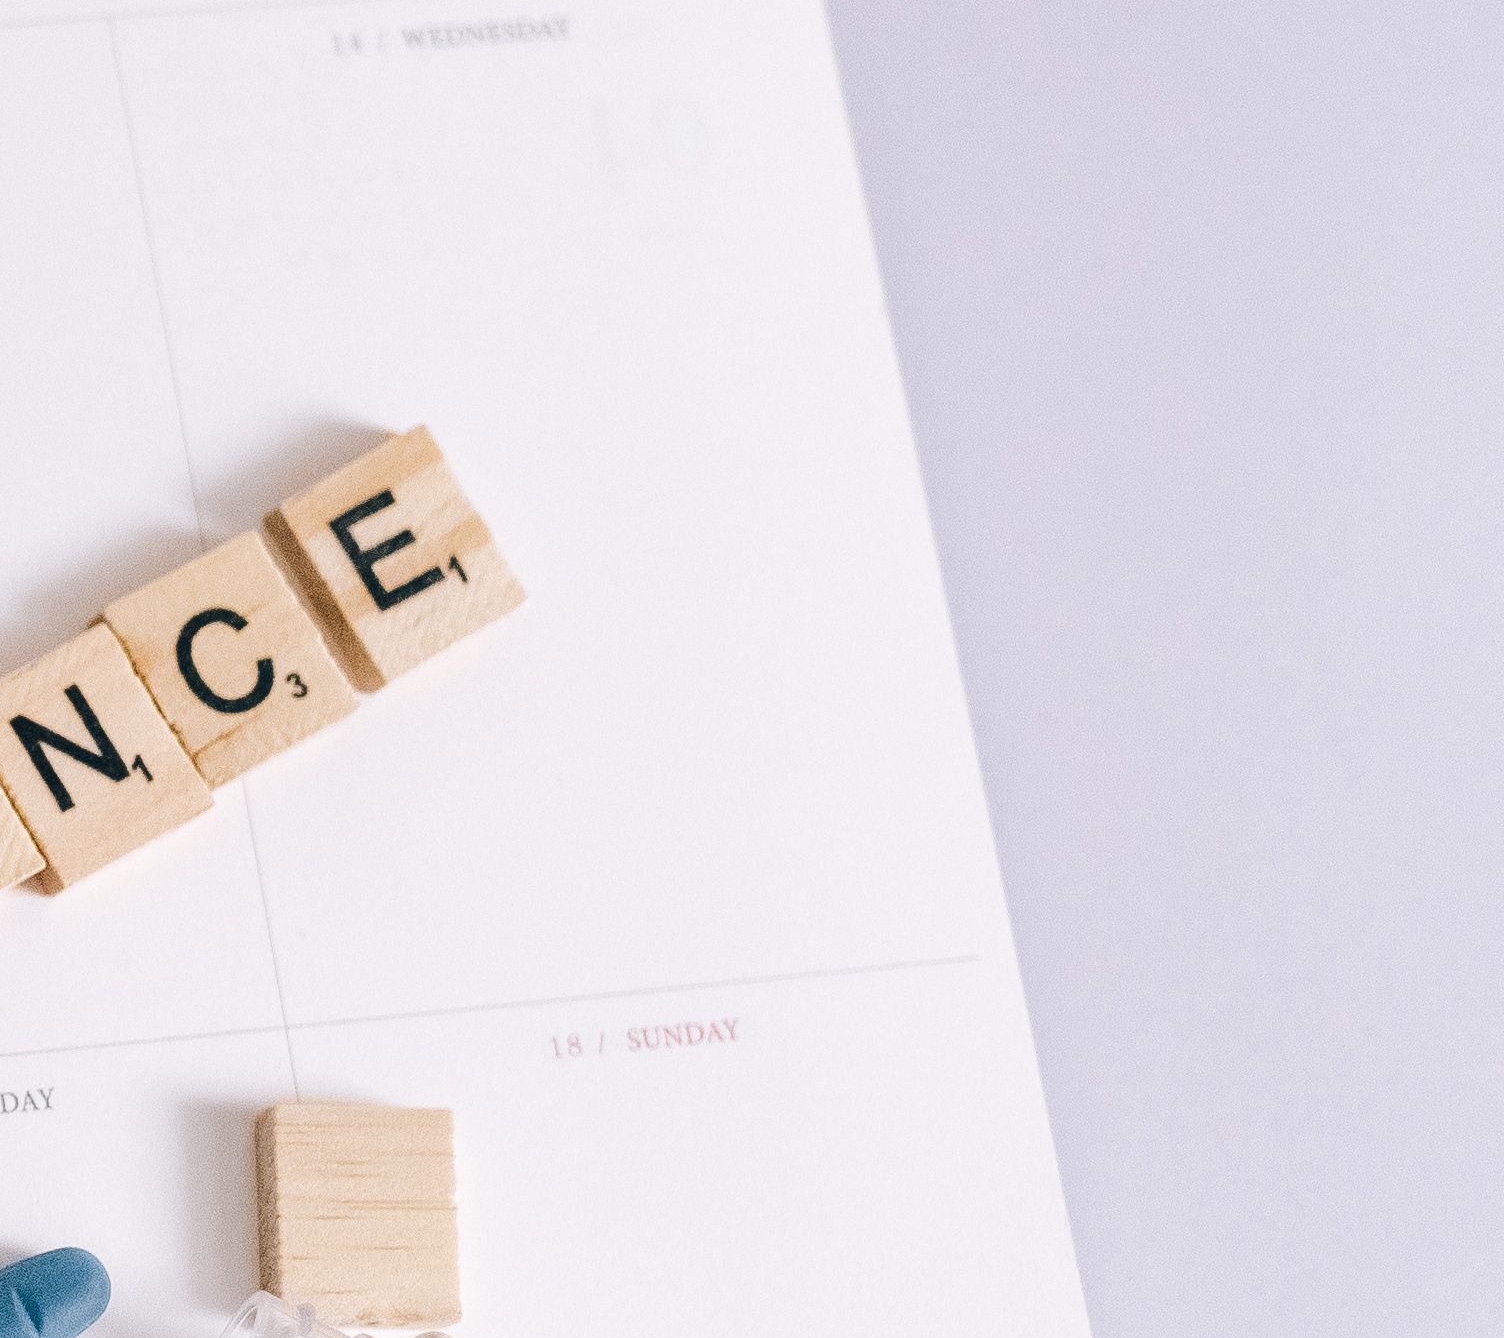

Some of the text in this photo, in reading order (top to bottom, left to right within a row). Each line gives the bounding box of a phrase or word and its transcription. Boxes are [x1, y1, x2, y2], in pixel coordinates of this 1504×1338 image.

[402, 17, 570, 49] WEDNESDAY
[445, 556, 469, 584] 1
[285, 673, 308, 699] 3
[130, 755, 154, 783] 1
[550, 1034, 584, 1059] 18
[626, 1019, 738, 1051] SUNDAY
